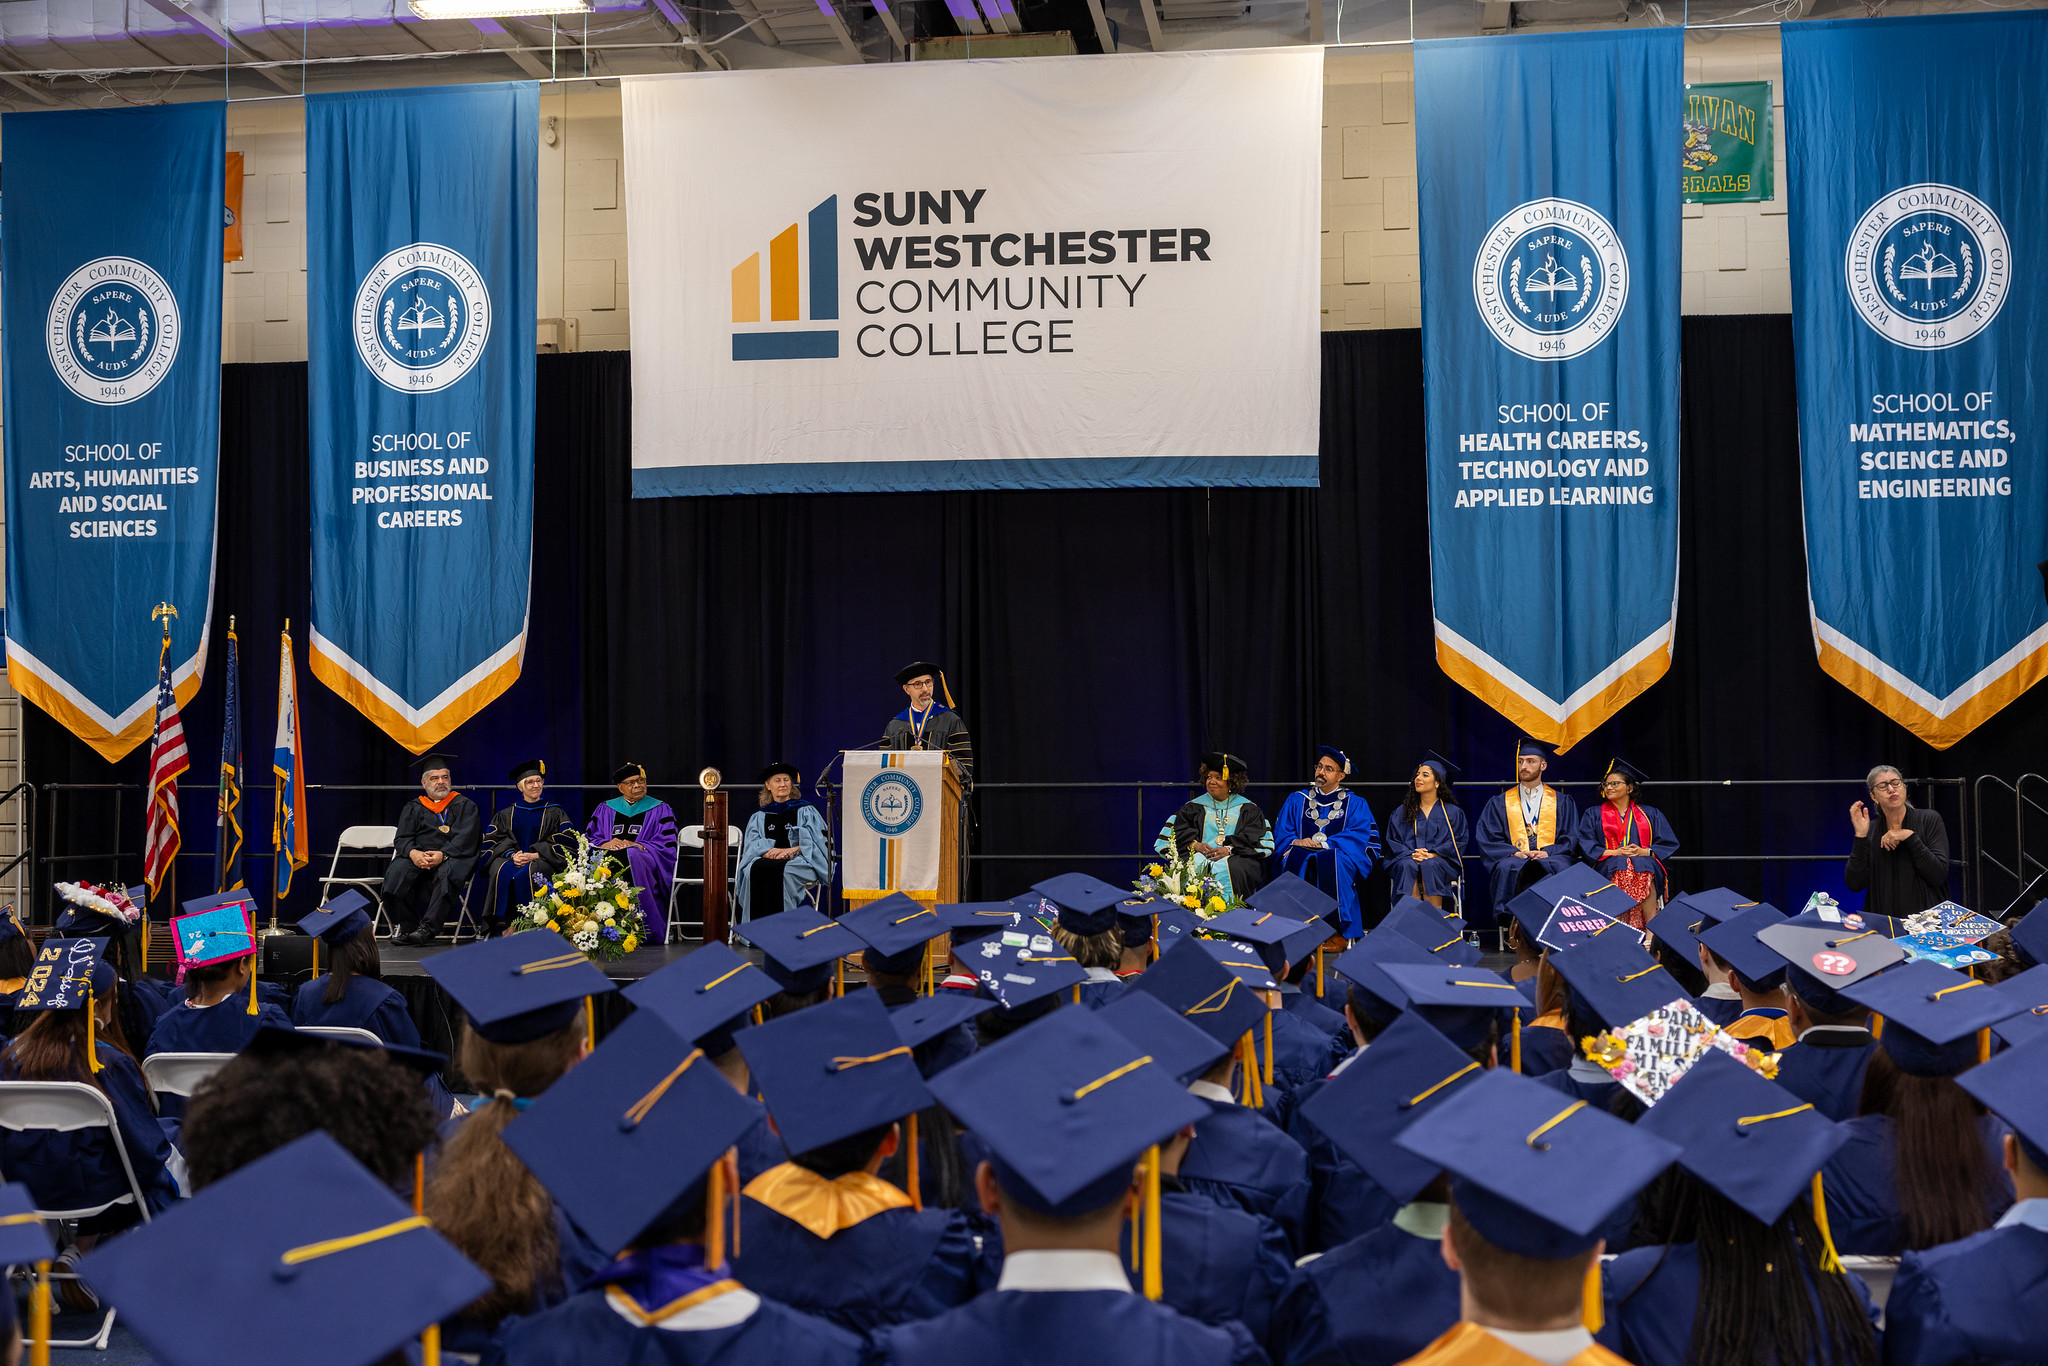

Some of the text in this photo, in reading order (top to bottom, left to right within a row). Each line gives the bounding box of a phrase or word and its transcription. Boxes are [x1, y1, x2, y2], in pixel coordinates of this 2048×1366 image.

[1683, 95, 1755, 146] IVAN
[853, 188, 986, 228] SUNY
[1902, 221, 1952, 237] SAPERE
[853, 228, 1212, 271] WESTCHESTER
[1527, 235, 1574, 251] SAPERE
[1854, 192, 2004, 326] WESTCHESTER COMMUNITY COLLEGE
[1483, 207, 1620, 338] WESTCHESTER COMMUNITY COLLEGE
[401, 277, 442, 292] SAPERE
[856, 273, 1148, 315] COMMUNITY
[92, 290, 132, 304] SAPERE
[1910, 298, 1948, 312] AUDE
[360, 251, 484, 373] WESTCHESTER COMMUNITY COLLEGE
[1534, 311, 1568, 323] AUDE
[54, 264, 174, 384] WESTCHESTER COMMUNITY COLLEGE
[1914, 326, 1946, 341] 1946
[856, 319, 1074, 358] COLLEGE
[1538, 338, 1566, 353] 1946
[405, 347, 437, 359] AUDE
[97, 359, 129, 371] AUDE
[408, 372, 434, 386] 1946
[99, 385, 126, 398] 1946
[1498, 402, 1610, 423] SCHOOL OF
[1872, 392, 1993, 414] SCHOOL OF
[371, 431, 471, 452] SCHOOL OF
[1459, 430, 1648, 453] HEALTH CAREERS,
[1850, 420, 2016, 443] MATHEMATICS,
[64, 442, 162, 462] SCHOOL OF
[1861, 449, 2007, 471] SCIENCE AND
[29, 466, 199, 491] ARTS, HUMANITIES
[354, 457, 489, 479] BUSINESS AND
[1458, 458, 1649, 479] TECHNOLOGY AND
[352, 483, 492, 504] PROFESSIONAL
[1454, 486, 1654, 508] APPLIED LEARNING
[1859, 477, 2012, 499] ENGINEERING
[58, 494, 167, 513] AND SOCIAL
[69, 519, 157, 538] SCIENCES
[377, 509, 462, 529] CAREERS
[881, 775, 917, 793] COMMUNITY
[906, 797, 920, 826] COLLEGE
[1561, 905, 1586, 918] ONE
[1558, 918, 1609, 933] DEGREE
[19, 947, 62, 1007] 2024
